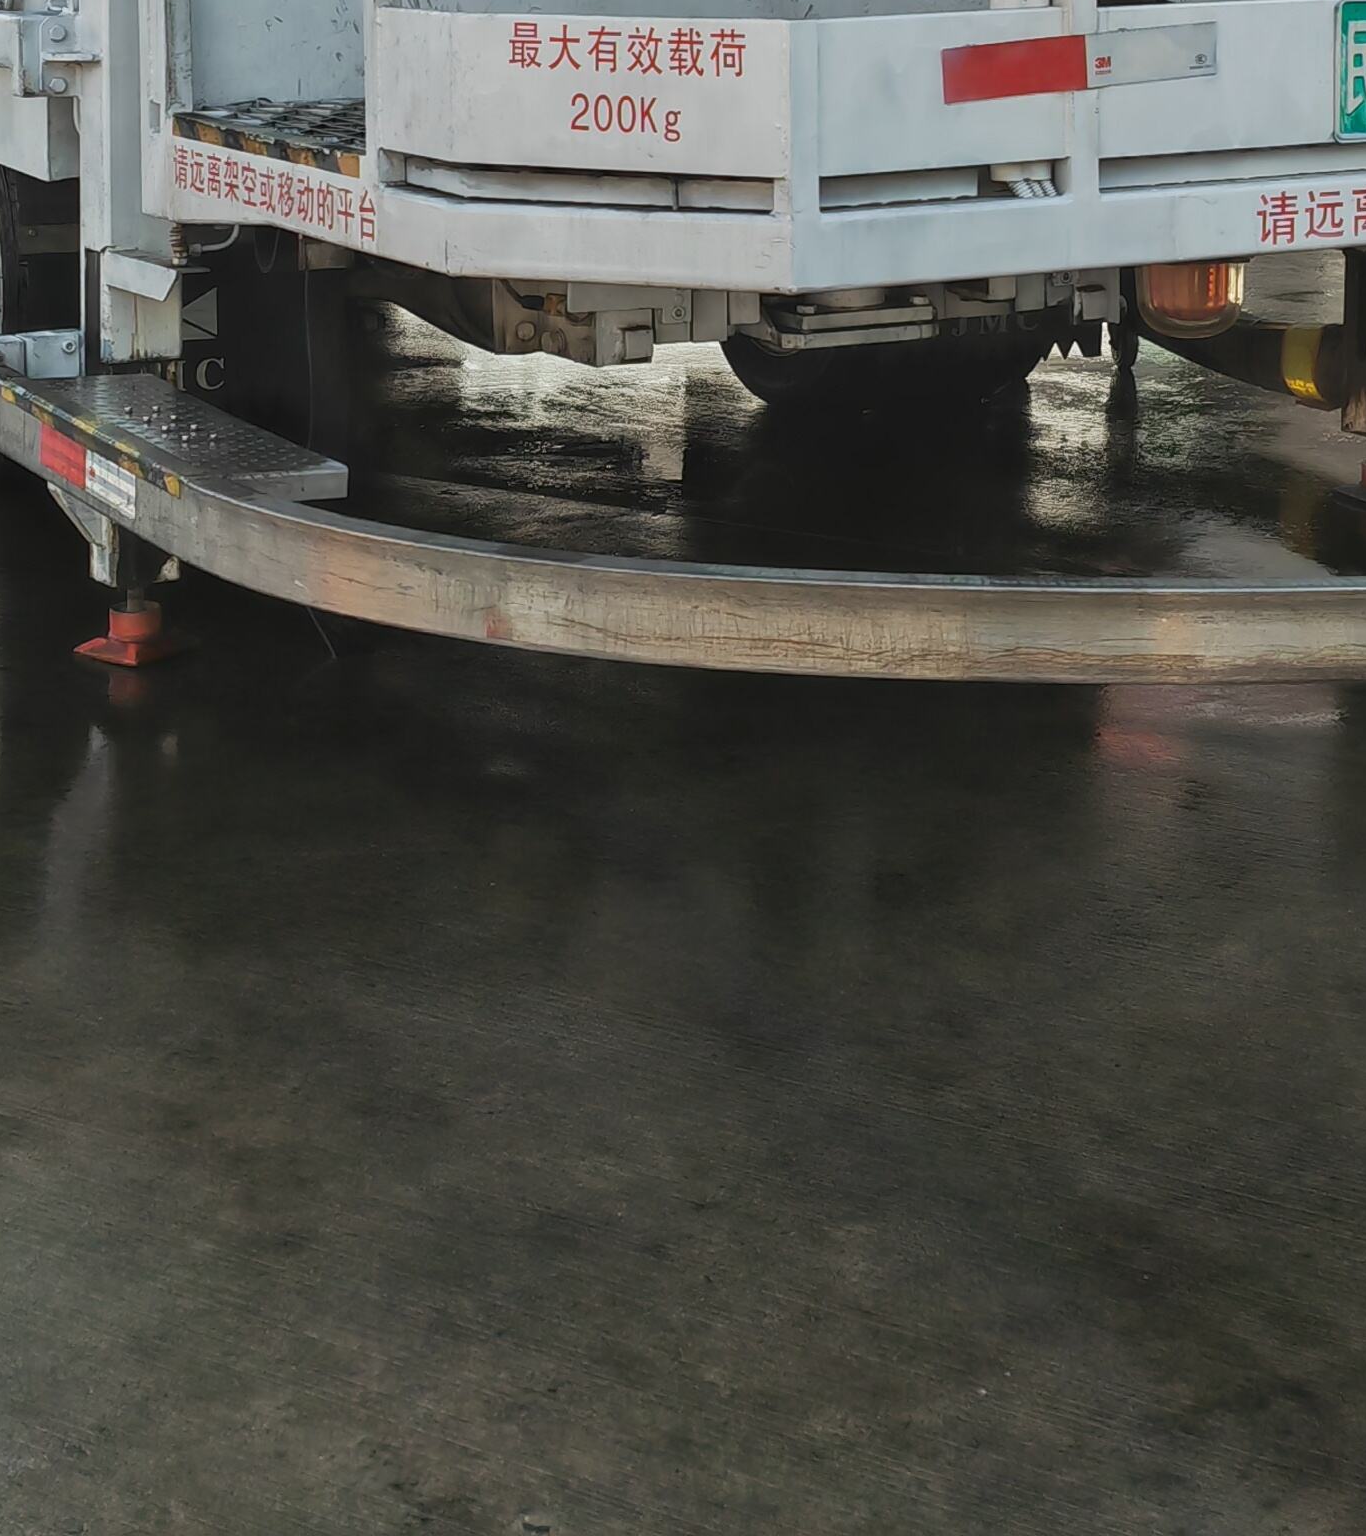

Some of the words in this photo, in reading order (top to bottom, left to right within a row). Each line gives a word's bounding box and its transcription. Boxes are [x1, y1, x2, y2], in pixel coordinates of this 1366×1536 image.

[508, 22, 747, 77] 最大有效载荷
[1095, 56, 1112, 69] 3M
[570, 93, 682, 142] 200Kg
[172, 145, 377, 242] 请远离架空或移动的平台
